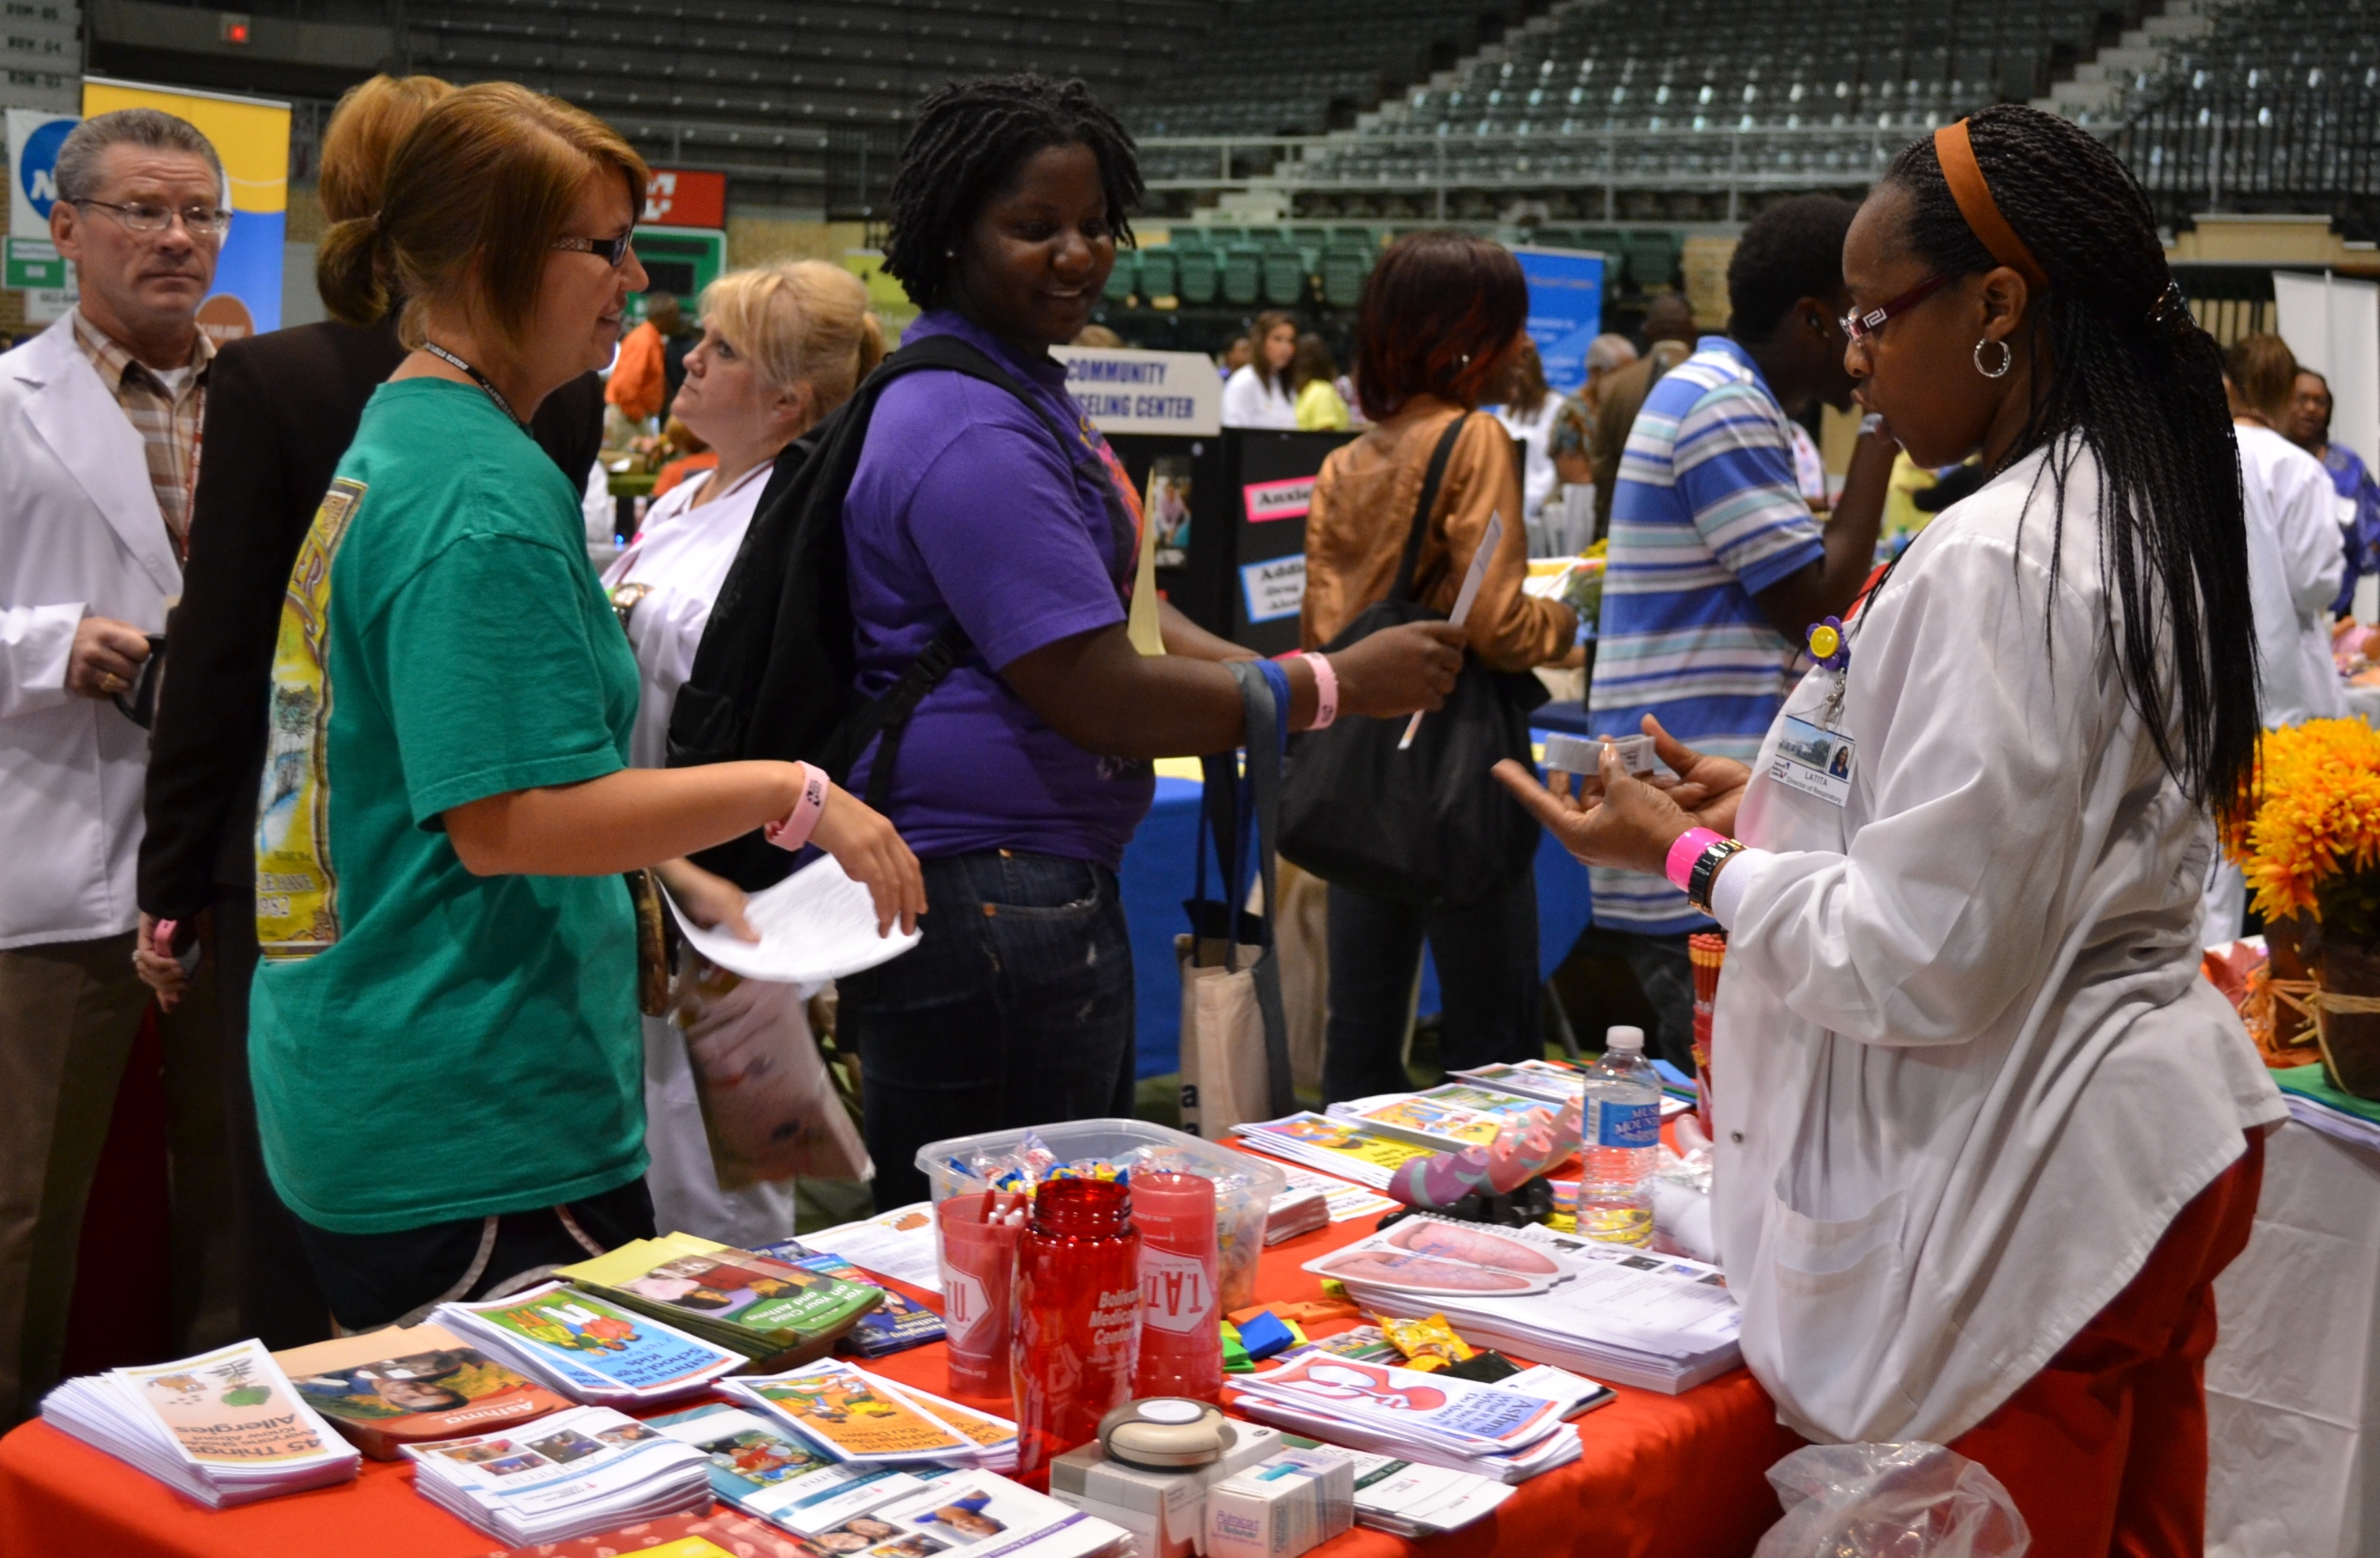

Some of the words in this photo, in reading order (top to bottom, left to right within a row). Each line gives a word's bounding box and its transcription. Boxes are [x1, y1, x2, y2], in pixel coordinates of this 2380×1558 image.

[1069, 358, 1167, 385] COMMUNITY
[1075, 394, 1130, 416] SELING
[1136, 395, 1194, 419] CENTER
[1805, 771, 1828, 787] LATITA
[1786, 776, 1807, 790] Director
[1813, 787, 1843, 804] Respiratory
[791, 1291, 818, 1306] and
[803, 1295, 833, 1310] Your
[745, 1302, 792, 1321] Asthma
[769, 1307, 806, 1324] Child
[611, 1347, 704, 1378] School-Age
[624, 1352, 662, 1367] Kids
[655, 1351, 717, 1375] Asthma
[623, 1374, 653, 1387] and
[1458, 1392, 1478, 1405] Do
[1470, 1393, 1497, 1411] What
[1486, 1397, 1513, 1414] What
[444, 1401, 535, 1423] Asthma
[1436, 1401, 1464, 1420] About
[1455, 1408, 1476, 1420] You
[1476, 1399, 1534, 1434] Asthma
[174, 1414, 295, 1434] Allergies
[246, 1426, 296, 1439] Know
[890, 1427, 922, 1436] You
[238, 1427, 318, 1447] Everyone
[287, 1438, 322, 1452] 45
[878, 1430, 949, 1445] Asthma
[897, 1439, 943, 1450] Don't
[188, 1445, 283, 1457] Things
[859, 1442, 893, 1451] Let
[1217, 1510, 1259, 1528] Pulmicort
